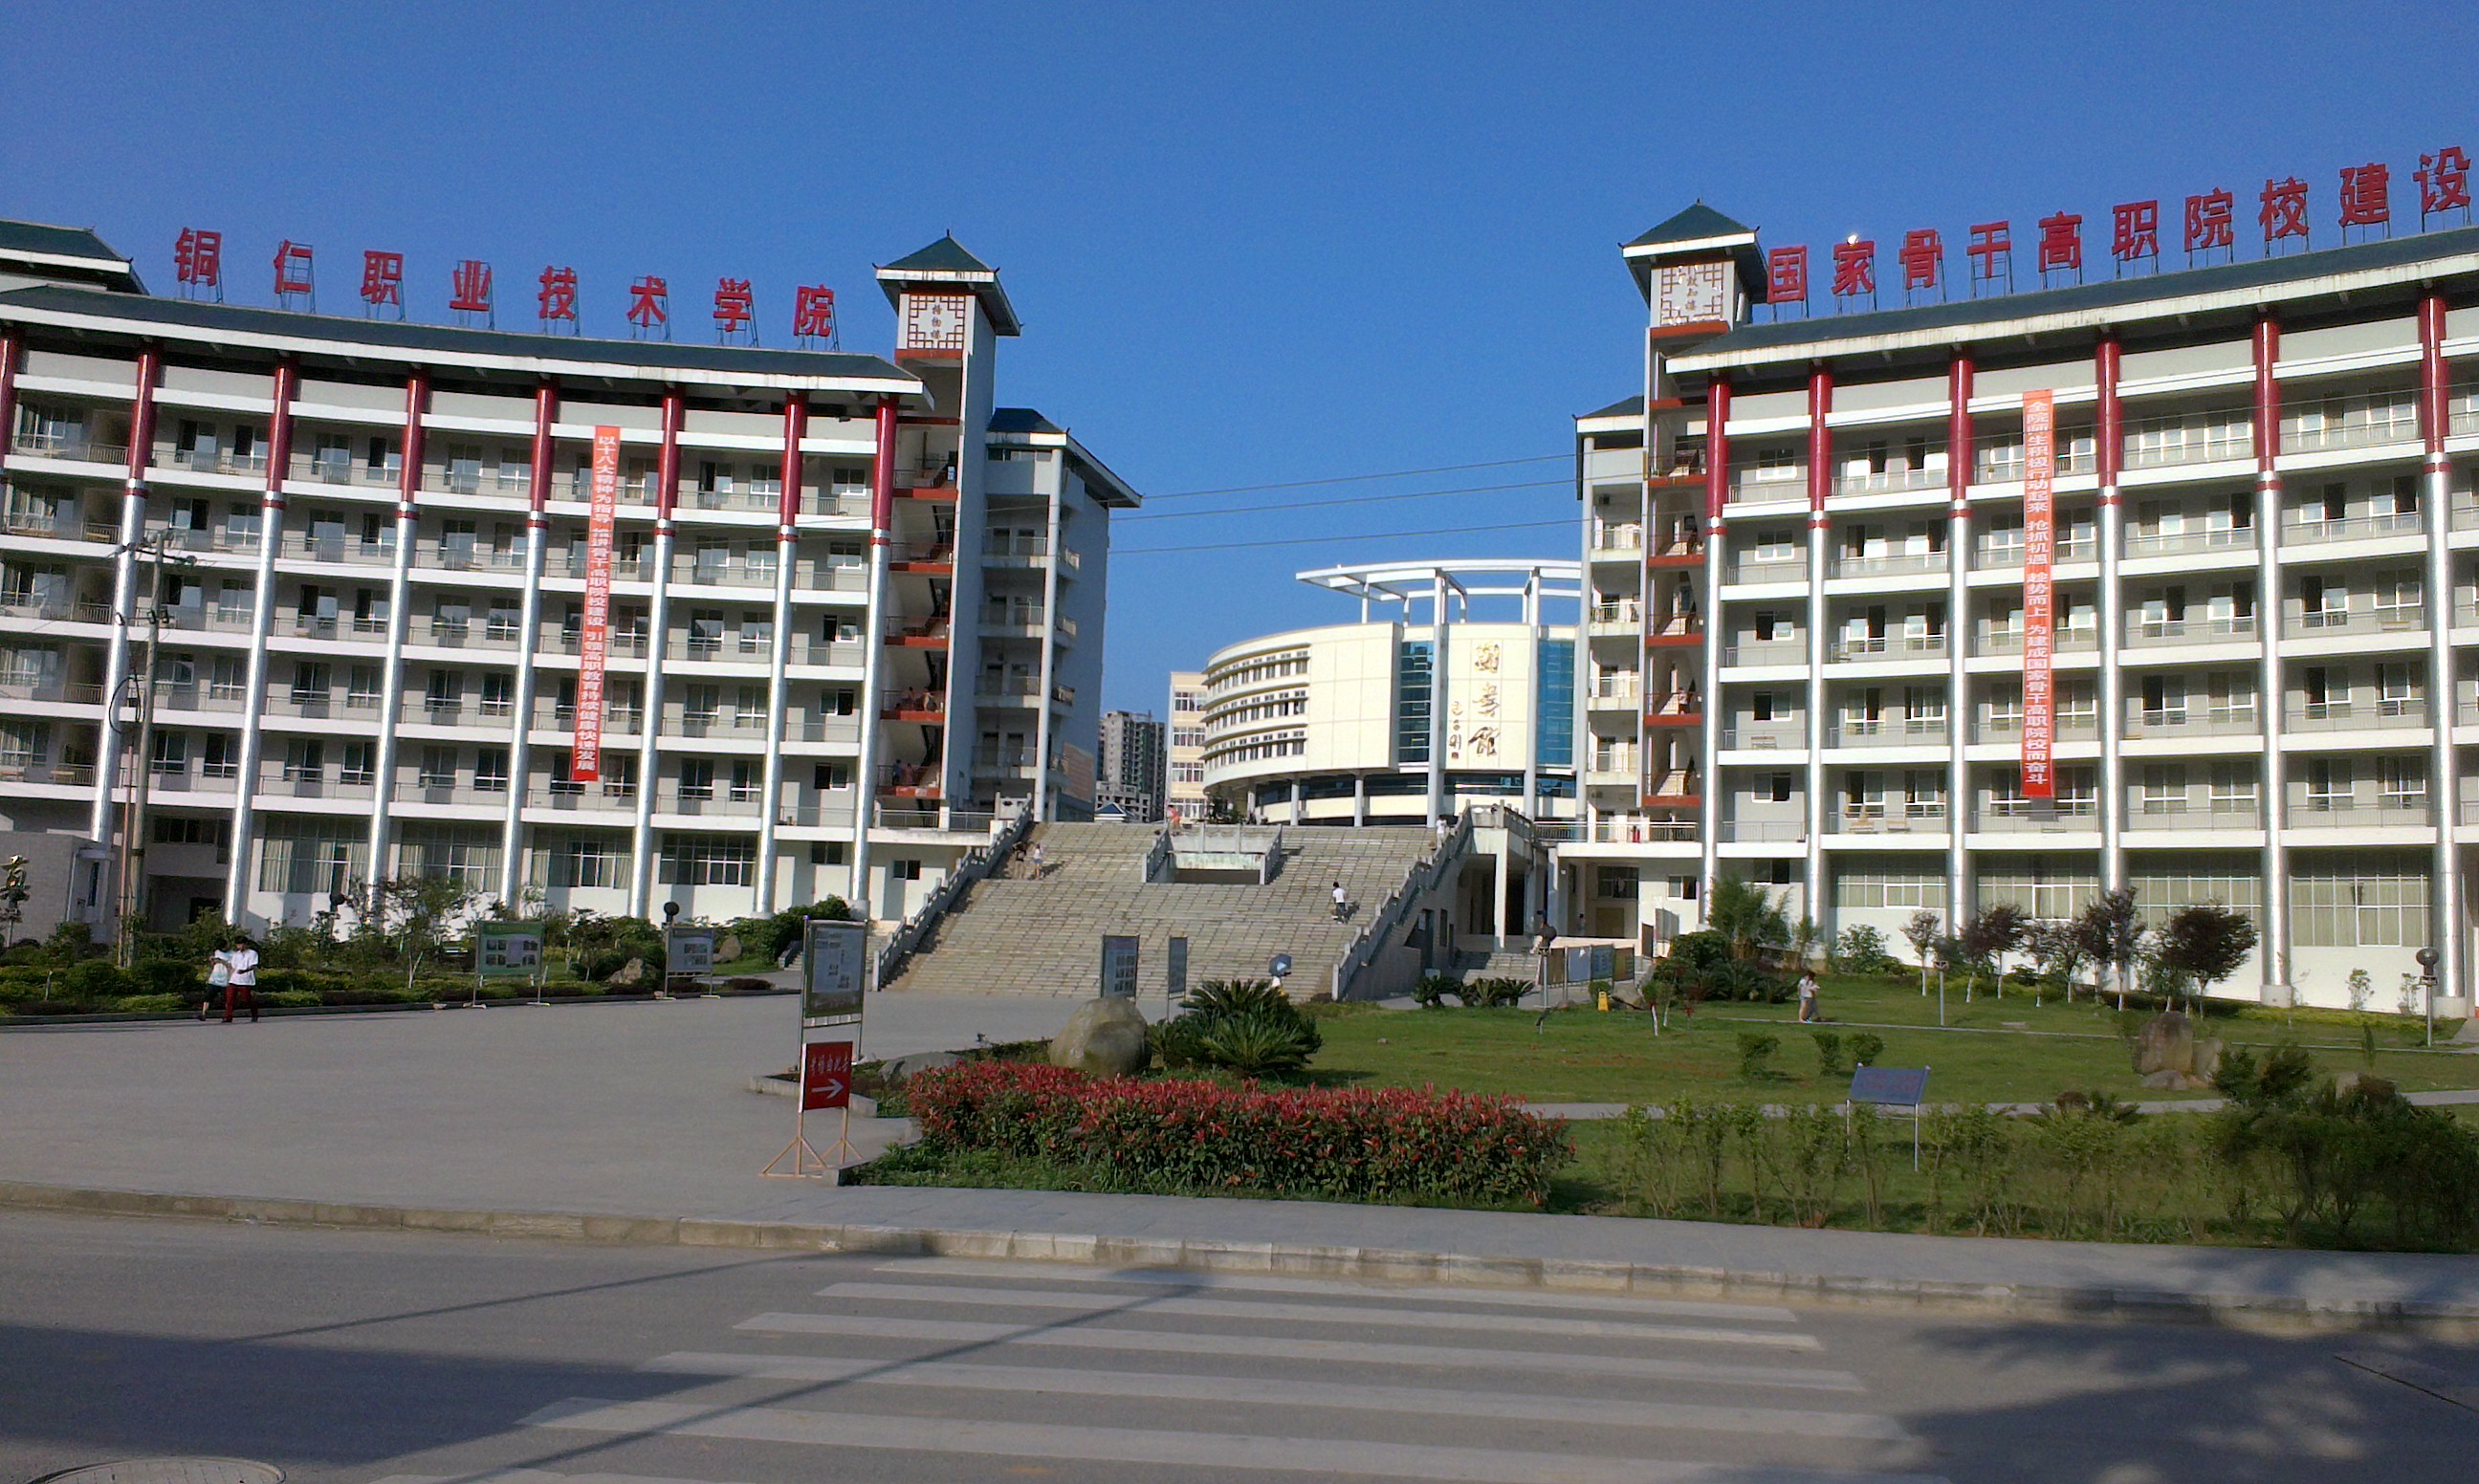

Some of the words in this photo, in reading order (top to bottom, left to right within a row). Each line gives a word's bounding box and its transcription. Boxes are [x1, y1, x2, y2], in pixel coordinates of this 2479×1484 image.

[174, 227, 835, 337] 铜仁职业技术学院
[1766, 146, 2470, 303] 国家骨干高职院校建设
[2027, 401, 2049, 513] 全院师生积极行动起来
[2025, 624, 2049, 785] 为建成国家骨干高职院校而奋斗
